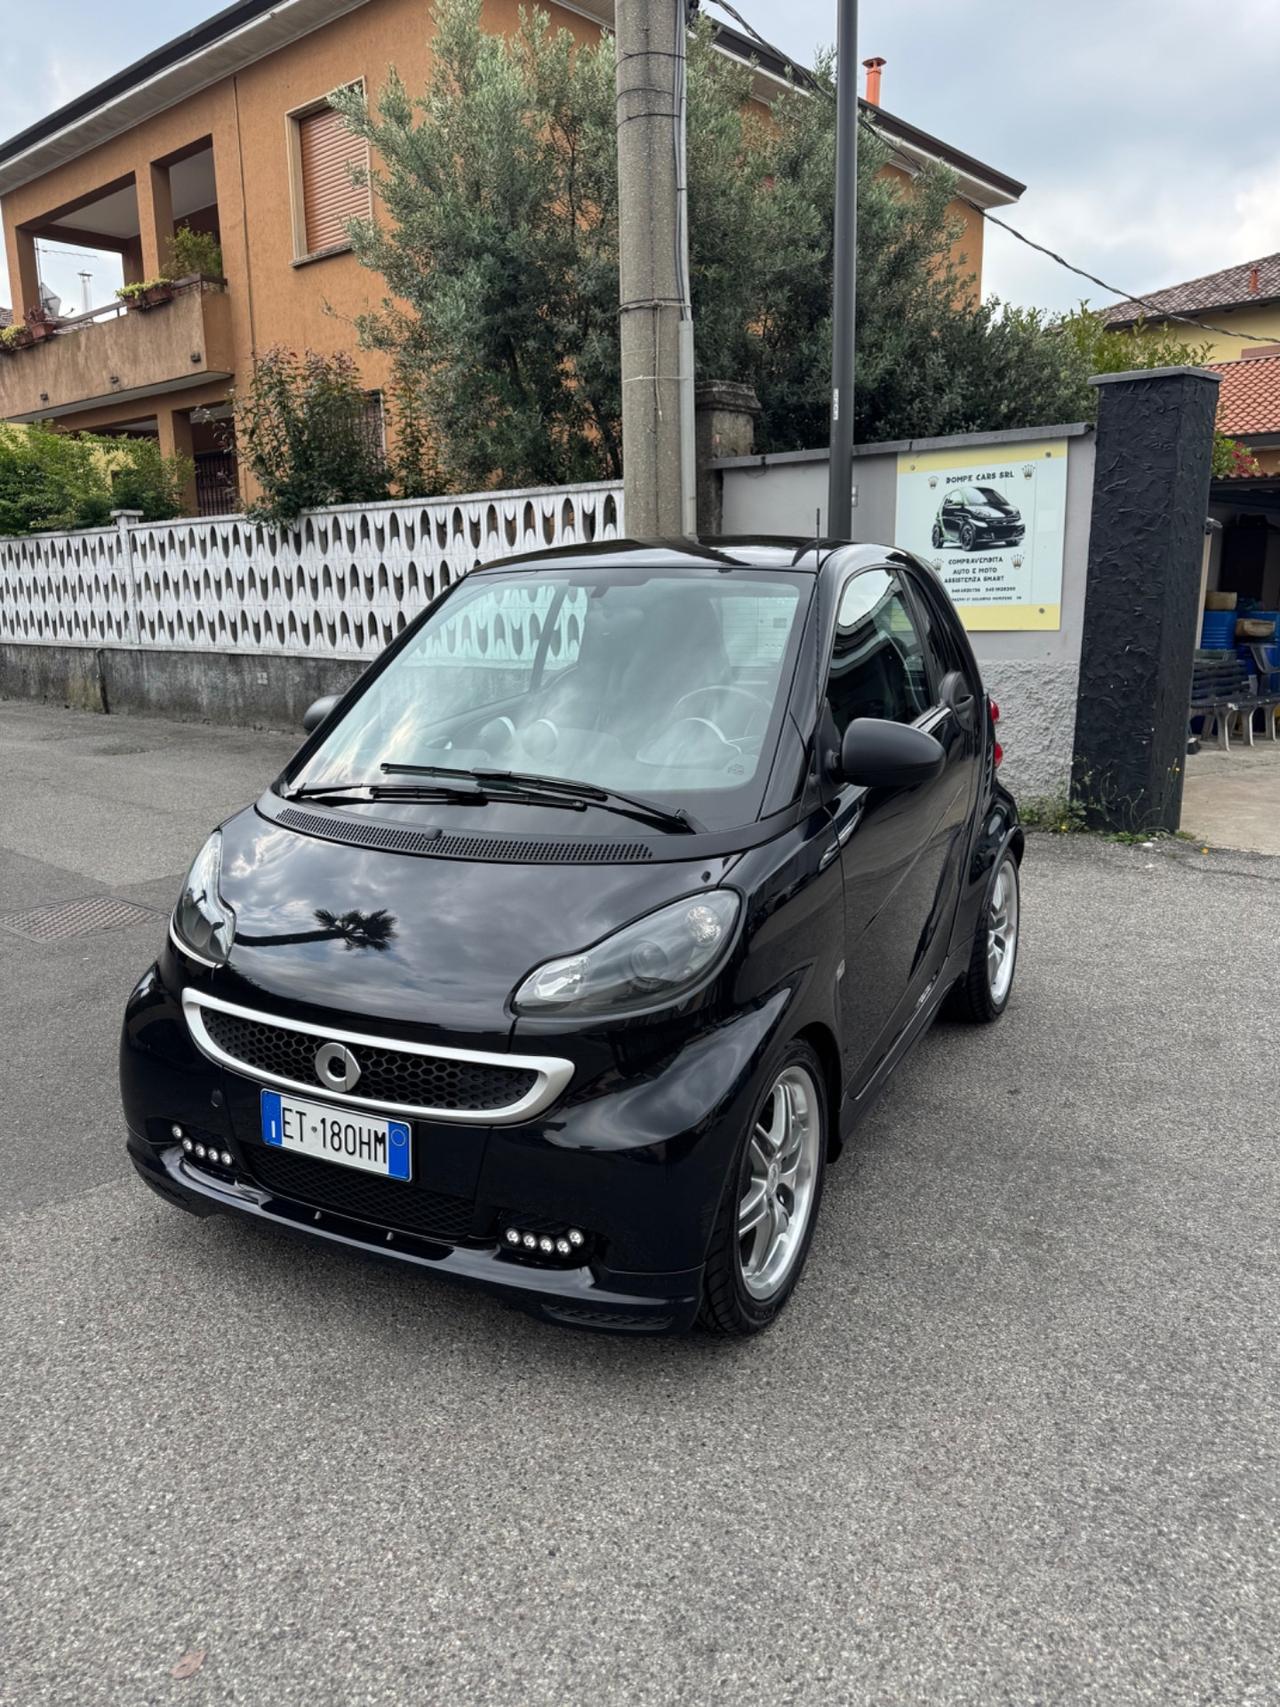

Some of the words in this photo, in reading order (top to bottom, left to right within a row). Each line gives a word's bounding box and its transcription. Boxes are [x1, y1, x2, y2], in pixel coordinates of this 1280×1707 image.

[976, 472, 996, 480] CARS
[999, 470, 1015, 479] SRL
[948, 557, 1003, 565] COMPRAVENDITA
